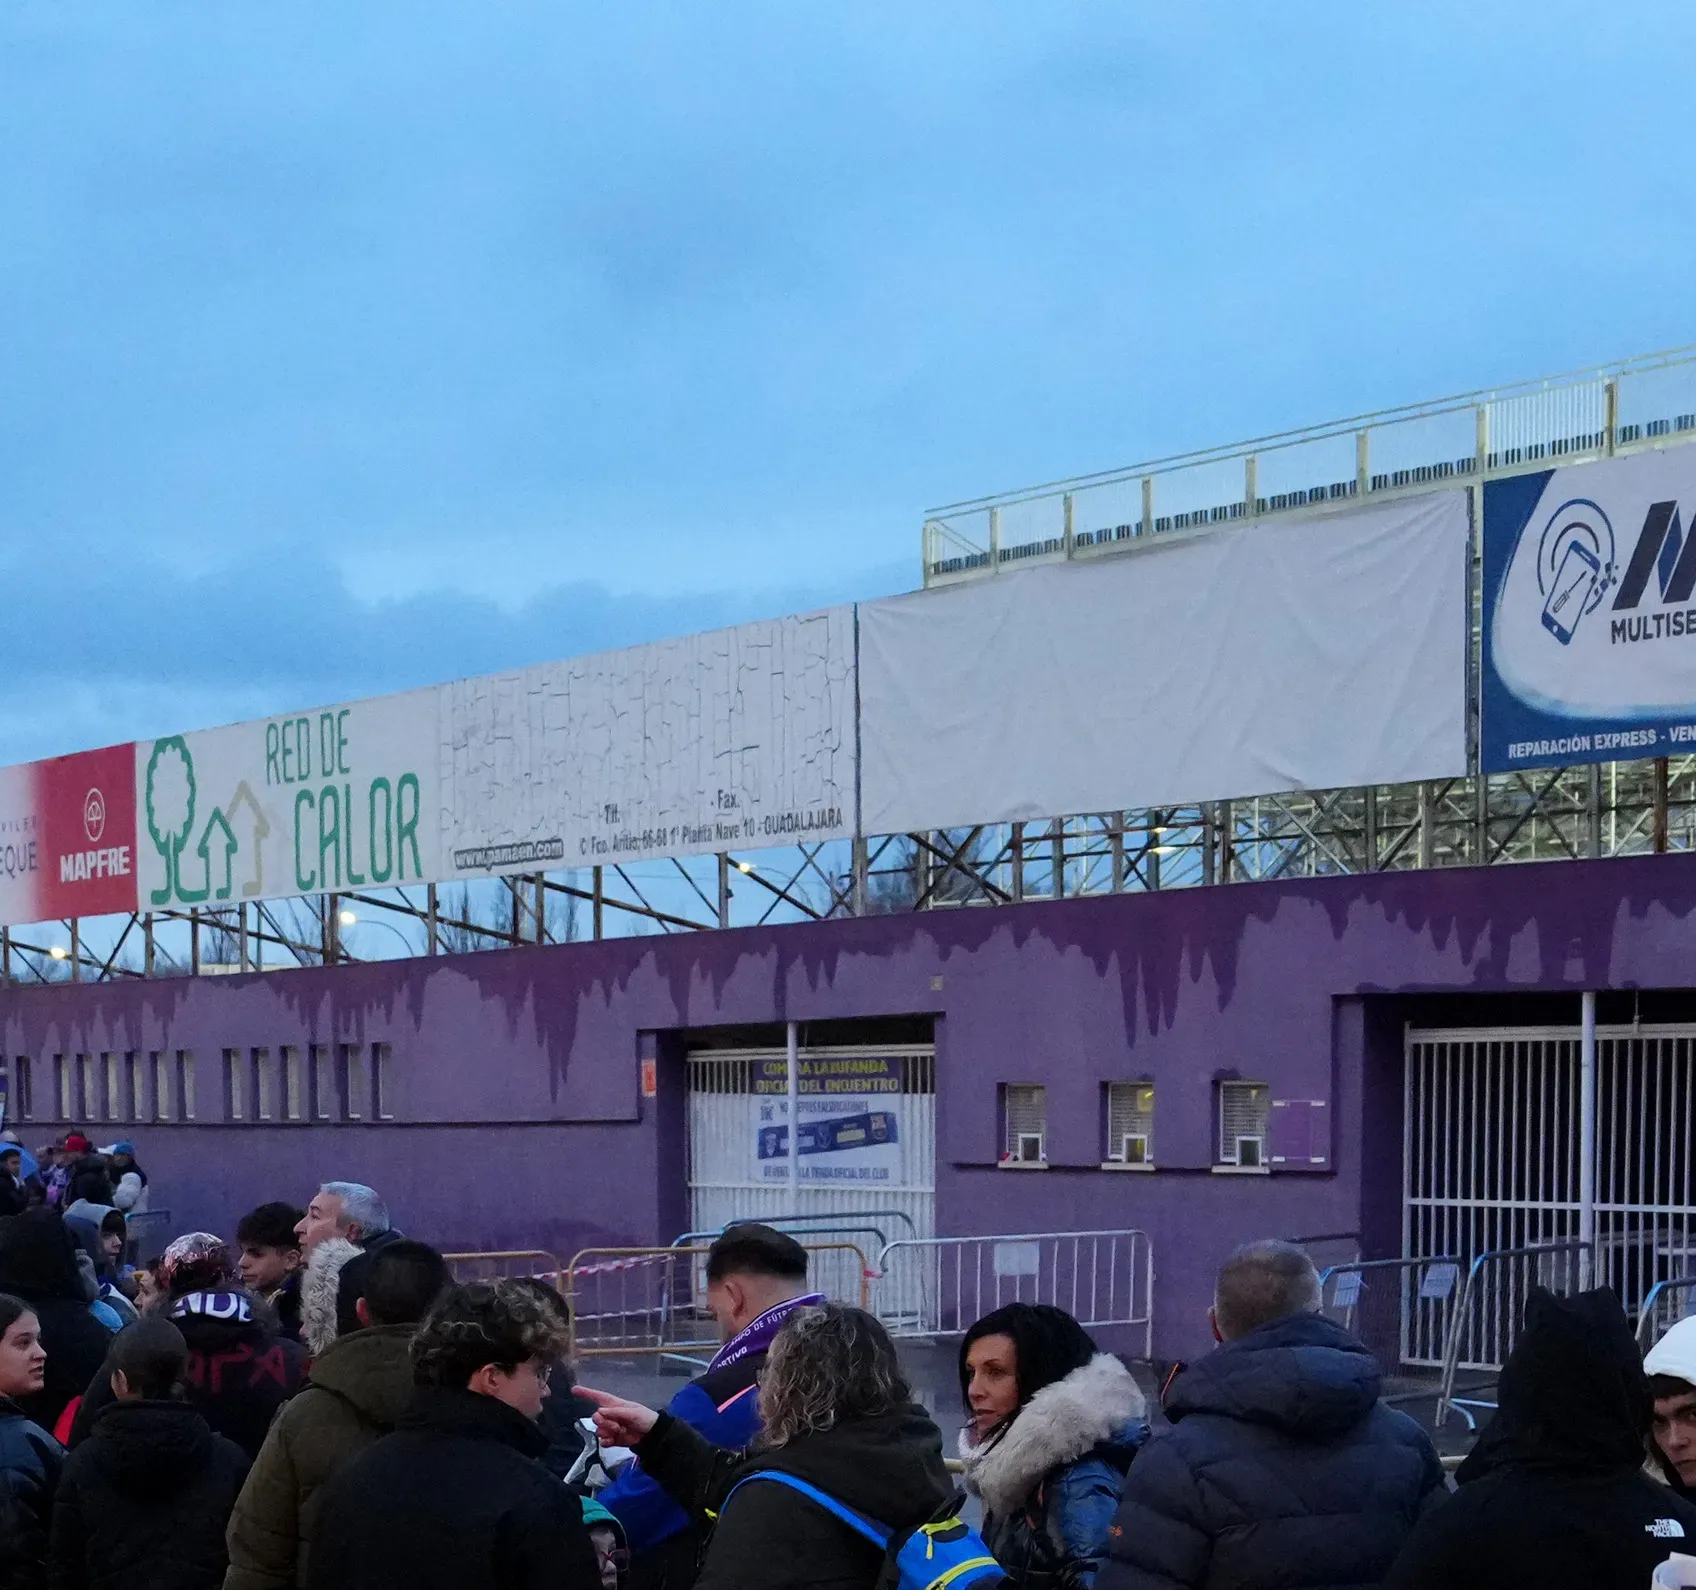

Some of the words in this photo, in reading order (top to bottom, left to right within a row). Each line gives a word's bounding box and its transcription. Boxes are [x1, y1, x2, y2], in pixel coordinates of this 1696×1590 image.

[266, 717, 311, 786] RED
[320, 709, 351, 778] DE
[1508, 734, 1591, 760] REPARACIÓN
[1595, 728, 1657, 750] EXPRESS
[717, 788, 741, 809] Fax.
[294, 772, 423, 892] CALOR
[715, 822, 740, 840] Nave
[743, 816, 755, 837] 10
[764, 807, 843, 836] GUADALAJARA
[60, 845, 131, 883] MAPFRE
[825, 1078, 899, 1092] ENCUENTRO
[753, 1321, 765, 1332] DE
